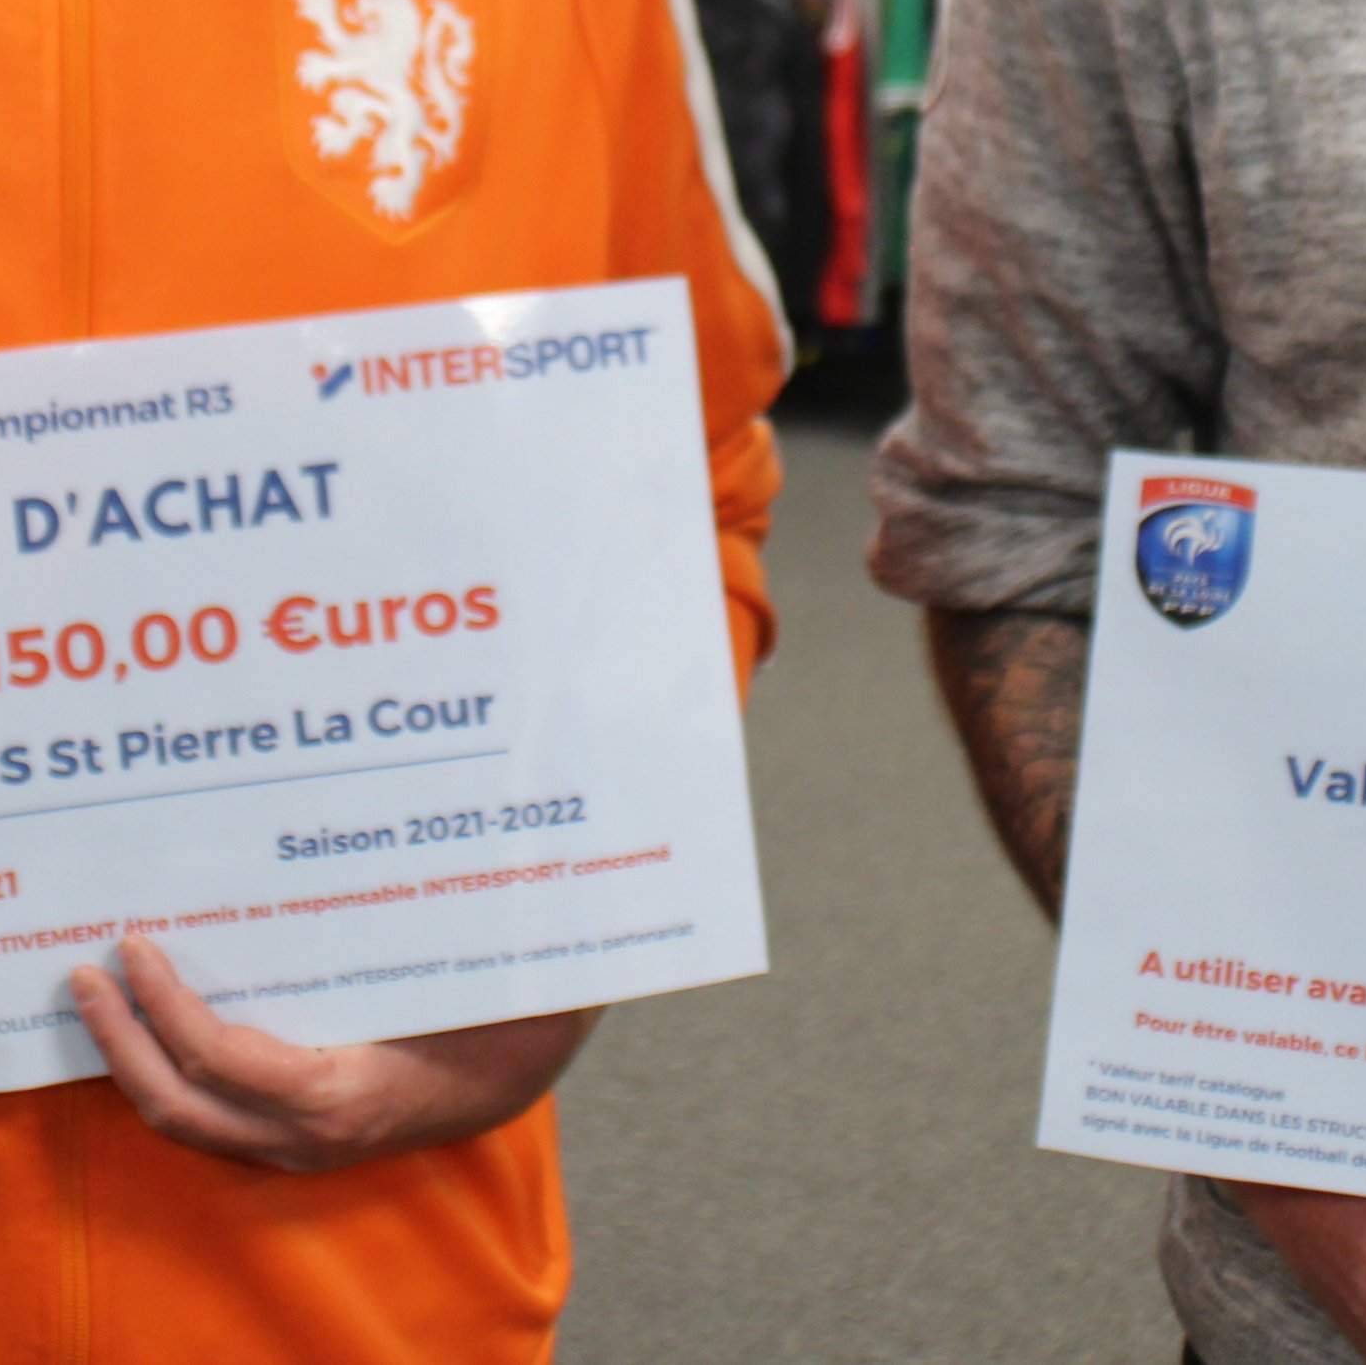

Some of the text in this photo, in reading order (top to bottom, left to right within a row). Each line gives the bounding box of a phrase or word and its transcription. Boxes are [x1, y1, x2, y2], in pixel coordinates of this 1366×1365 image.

[360, 324, 651, 395] INTERSPORT
[184, 381, 235, 418] R3
[12, 459, 339, 556] D'ACHAT
[1167, 480, 1230, 500] LIGUE
[263, 583, 500, 654] €uros
[46, 736, 104, 781] St
[116, 720, 279, 772] Pierre
[292, 707, 354, 750] La
[366, 693, 494, 740] Cour
[275, 793, 587, 863] Saison 2021-2022
[174, 904, 240, 929] remis
[244, 902, 273, 921] au
[277, 882, 418, 916] responsable
[421, 858, 567, 897] INTERSPORT
[571, 843, 671, 878] concerné
[249, 975, 331, 1000] indiqués
[331, 957, 450, 989] INTERSPORT
[451, 954, 498, 975] dans
[498, 950, 518, 968] le
[519, 943, 571, 965] cadre
[570, 938, 598, 957] du
[598, 921, 694, 956] partenariat
[1138, 948, 1164, 978] A
[1173, 956, 1299, 996] utiliser
[1133, 1009, 1188, 1035] Pour
[1190, 1017, 1238, 1043] être
[1241, 1028, 1328, 1057] valable,
[1333, 1041, 1360, 1060] ce
[1084, 1083, 1127, 1106] BON
[1128, 1090, 1211, 1119] VALABLE
[1213, 1102, 1267, 1127] DANS
[1269, 1111, 1304, 1133] LES
[1099, 1062, 1287, 1104] Valeur tarif catalogue
[1080, 1112, 1129, 1135] signé
[1130, 1120, 1172, 1141] avec
[1174, 1125, 1193, 1144] la
[1195, 1128, 1245, 1152] Ligue
[1245, 1136, 1272, 1156] de
[1273, 1138, 1349, 1167] Football
